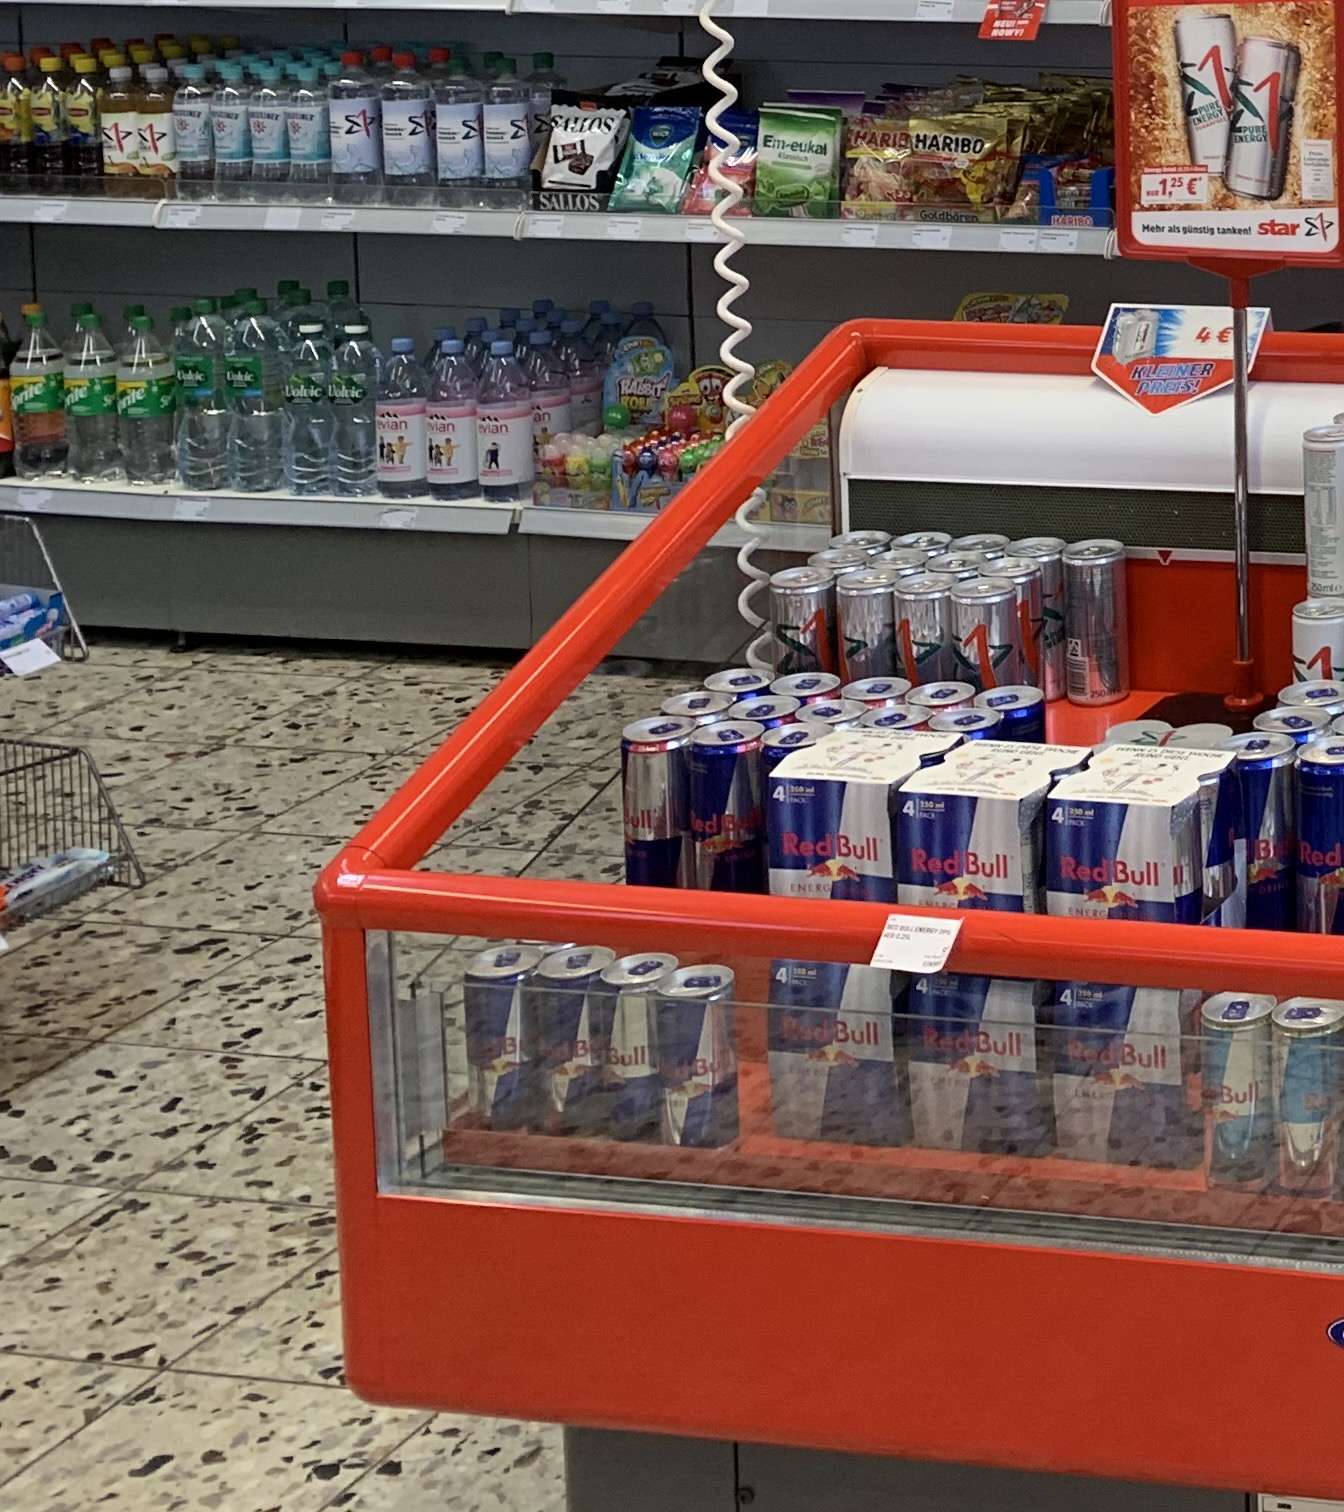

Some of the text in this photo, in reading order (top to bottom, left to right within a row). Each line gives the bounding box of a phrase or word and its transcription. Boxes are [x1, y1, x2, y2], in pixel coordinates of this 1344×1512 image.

[991, 28, 1024, 36] NOWY!
[551, 113, 615, 135] SALLOS
[1242, 125, 1267, 134] PURE
[763, 135, 827, 156] Em-eukal
[915, 133, 985, 155] HARIBO
[1234, 133, 1268, 143] ENERGY
[540, 193, 600, 211] SALLOS
[1051, 215, 1093, 227] HARIBO
[1142, 224, 1252, 235] Mehr als günstig tanken!
[1257, 219, 1300, 236] star
[1195, 327, 1234, 343] 4 €
[1132, 363, 1215, 379] KLEINER
[1136, 379, 1202, 395] PREIS!
[377, 419, 408, 431] evian
[773, 786, 785, 802] 4
[902, 800, 915, 817] 4
[1052, 807, 1064, 824] 4
[782, 832, 879, 861] Red Bull
[912, 848, 1008, 879] Red Bull
[1060, 856, 1159, 886] Red Bull
[775, 966, 787, 984] 4
[1059, 990, 1073, 1006] 4
[835, 1021, 879, 1046] Bull
[976, 1031, 1022, 1057] Bull
[1120, 1043, 1167, 1070] Bull
